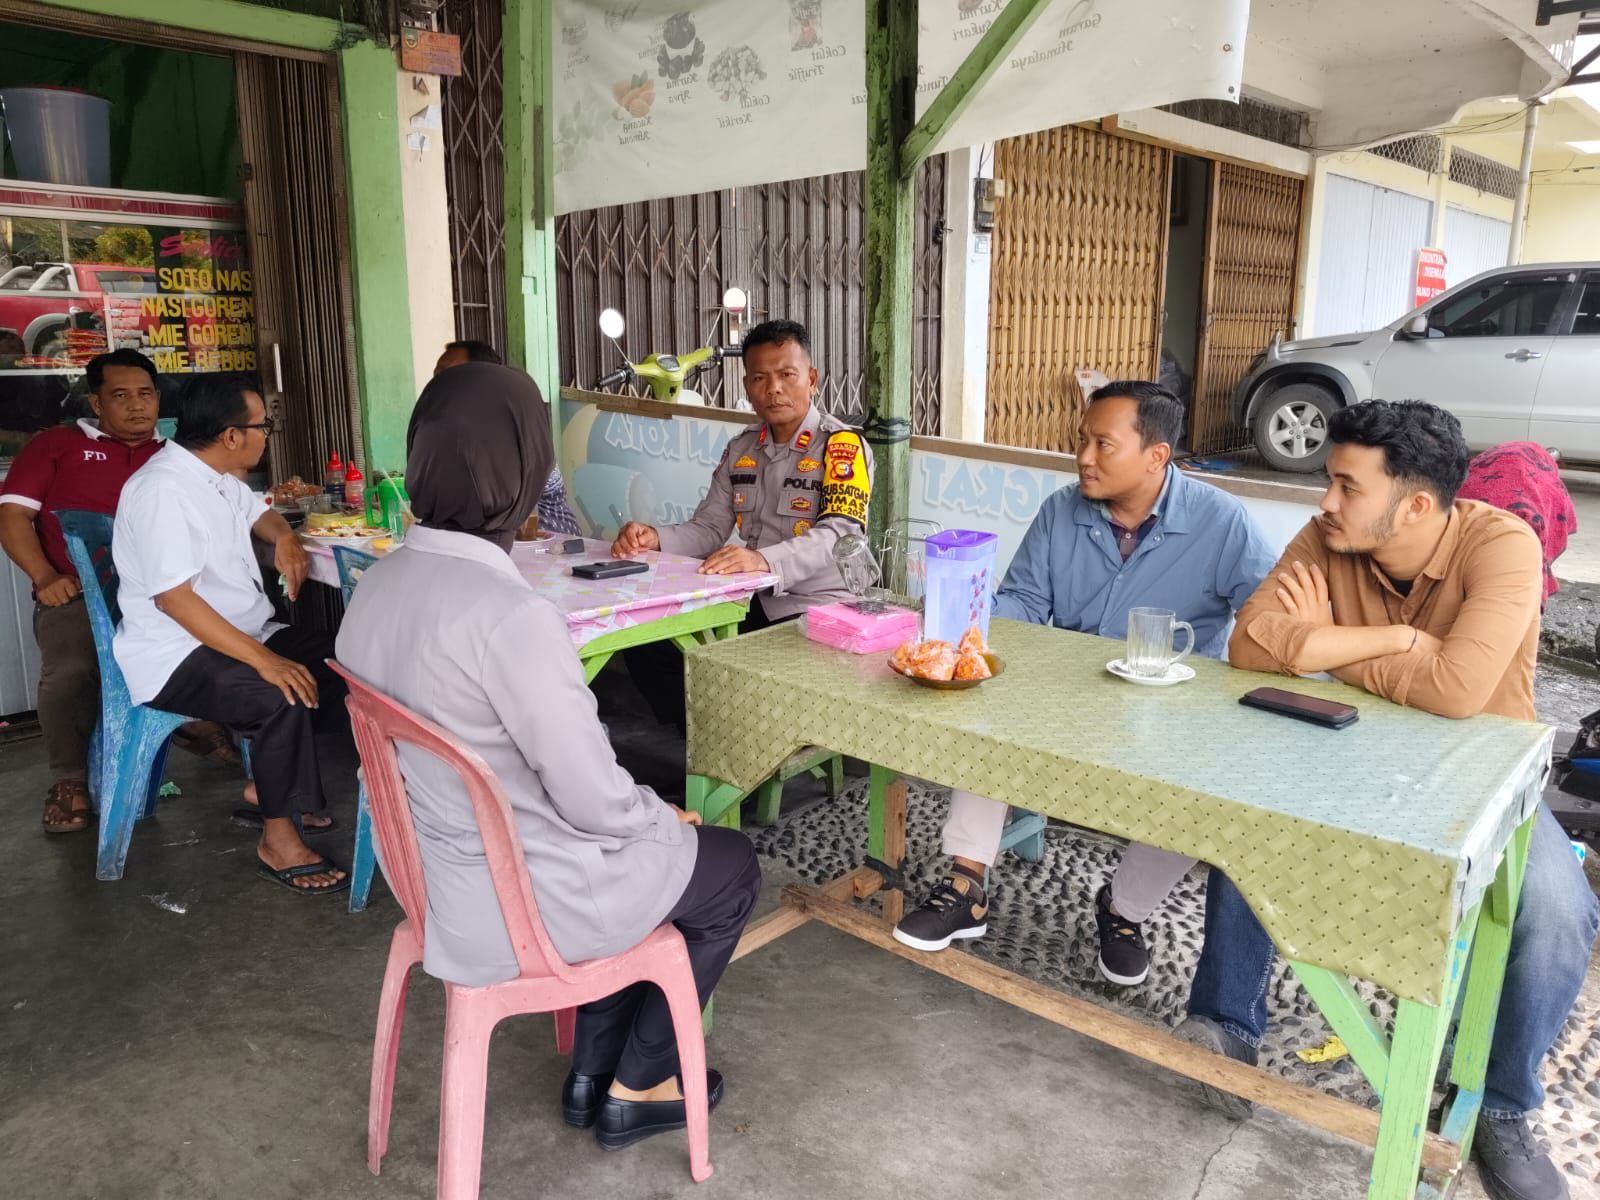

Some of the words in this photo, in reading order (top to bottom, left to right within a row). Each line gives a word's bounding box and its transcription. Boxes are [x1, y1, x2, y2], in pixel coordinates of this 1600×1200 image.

[158, 267, 213, 291] SOTO
[140, 295, 187, 318] NASI
[148, 323, 186, 347] MIE
[188, 324, 256, 347] GOREN
[153, 351, 190, 374] MIE
[194, 351, 257, 373] REBUS
